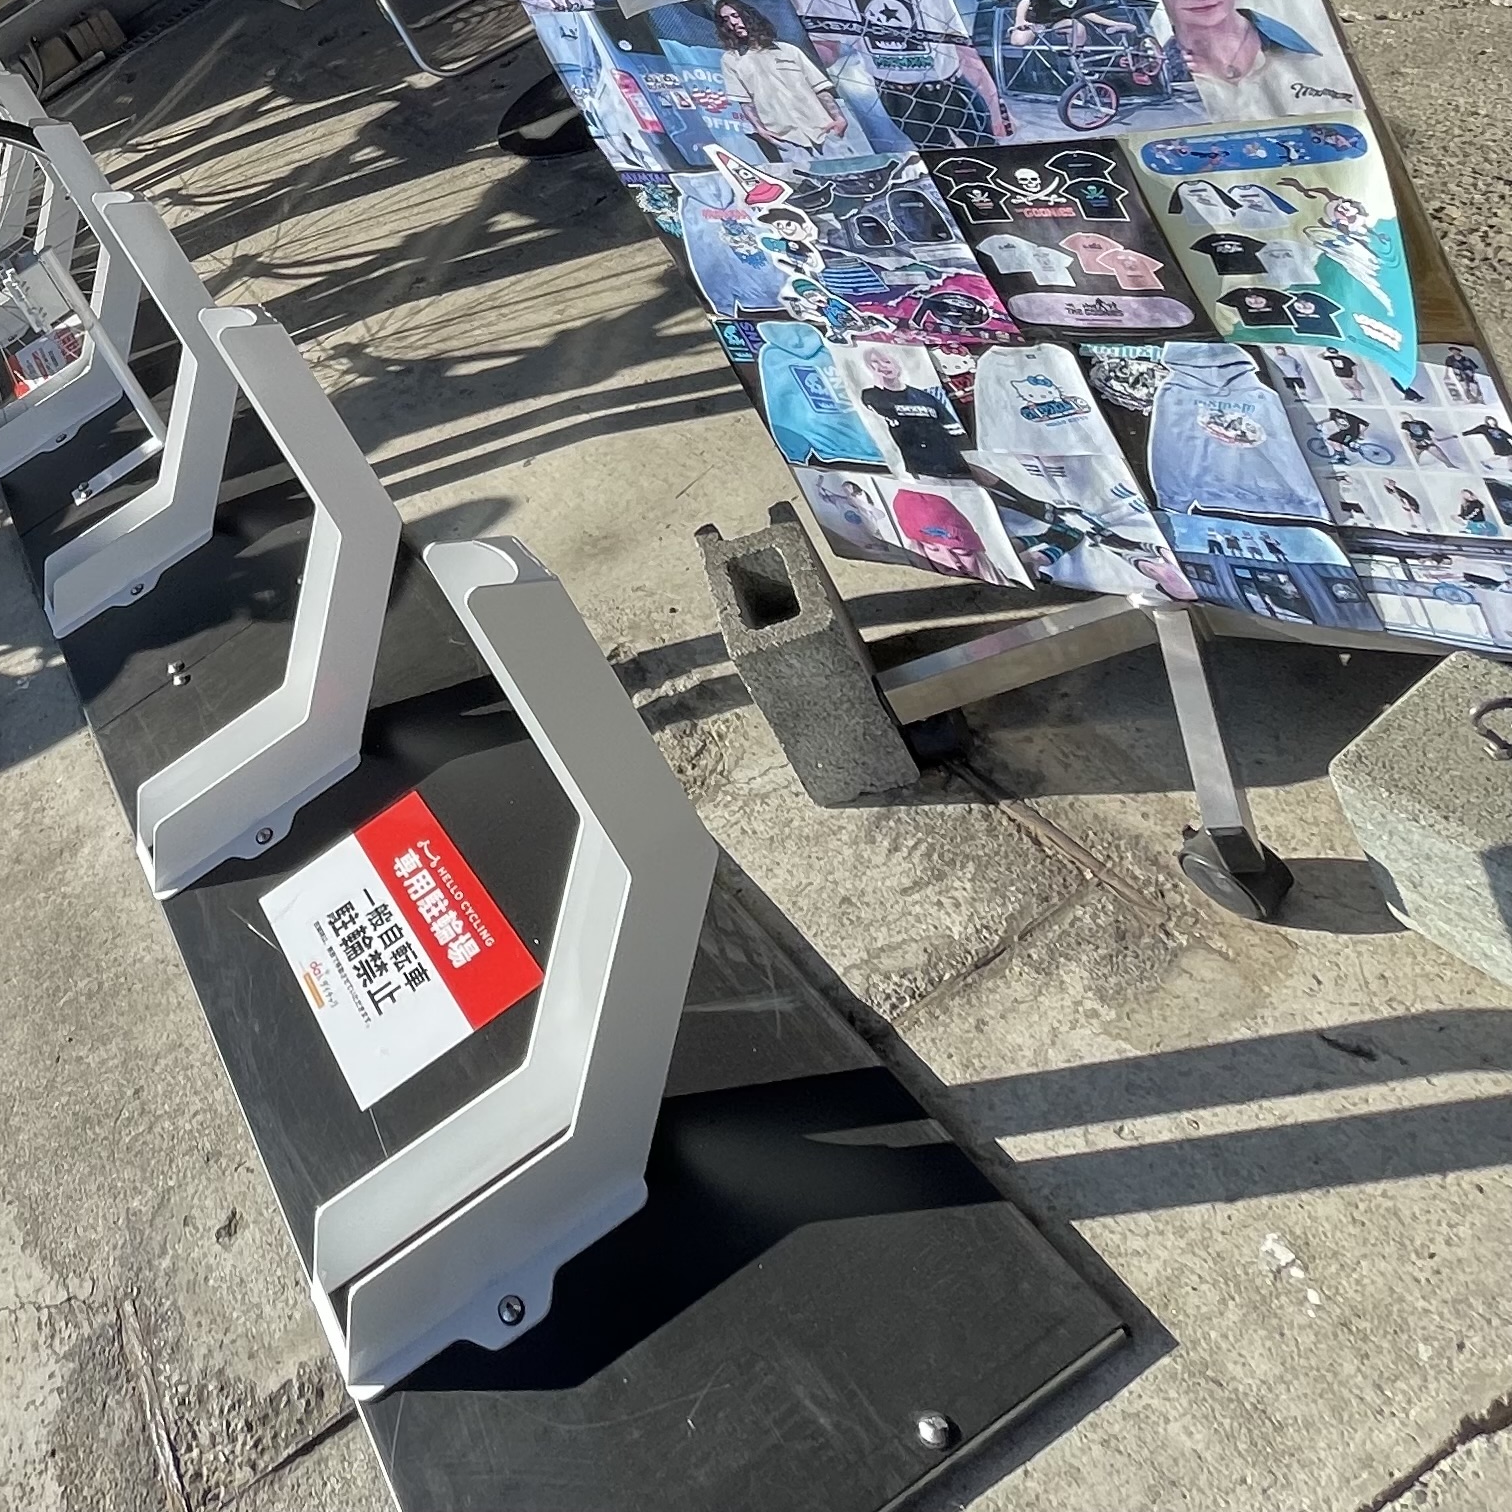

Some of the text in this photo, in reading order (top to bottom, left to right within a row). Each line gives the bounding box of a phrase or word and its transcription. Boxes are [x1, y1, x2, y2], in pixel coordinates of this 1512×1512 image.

[325, 899, 402, 1017] 駐輪禁止
[362, 887, 432, 993] 一般自転車
[392, 847, 482, 969] 専用駐輪場
[436, 865, 497, 948] HELLO CYCLING
